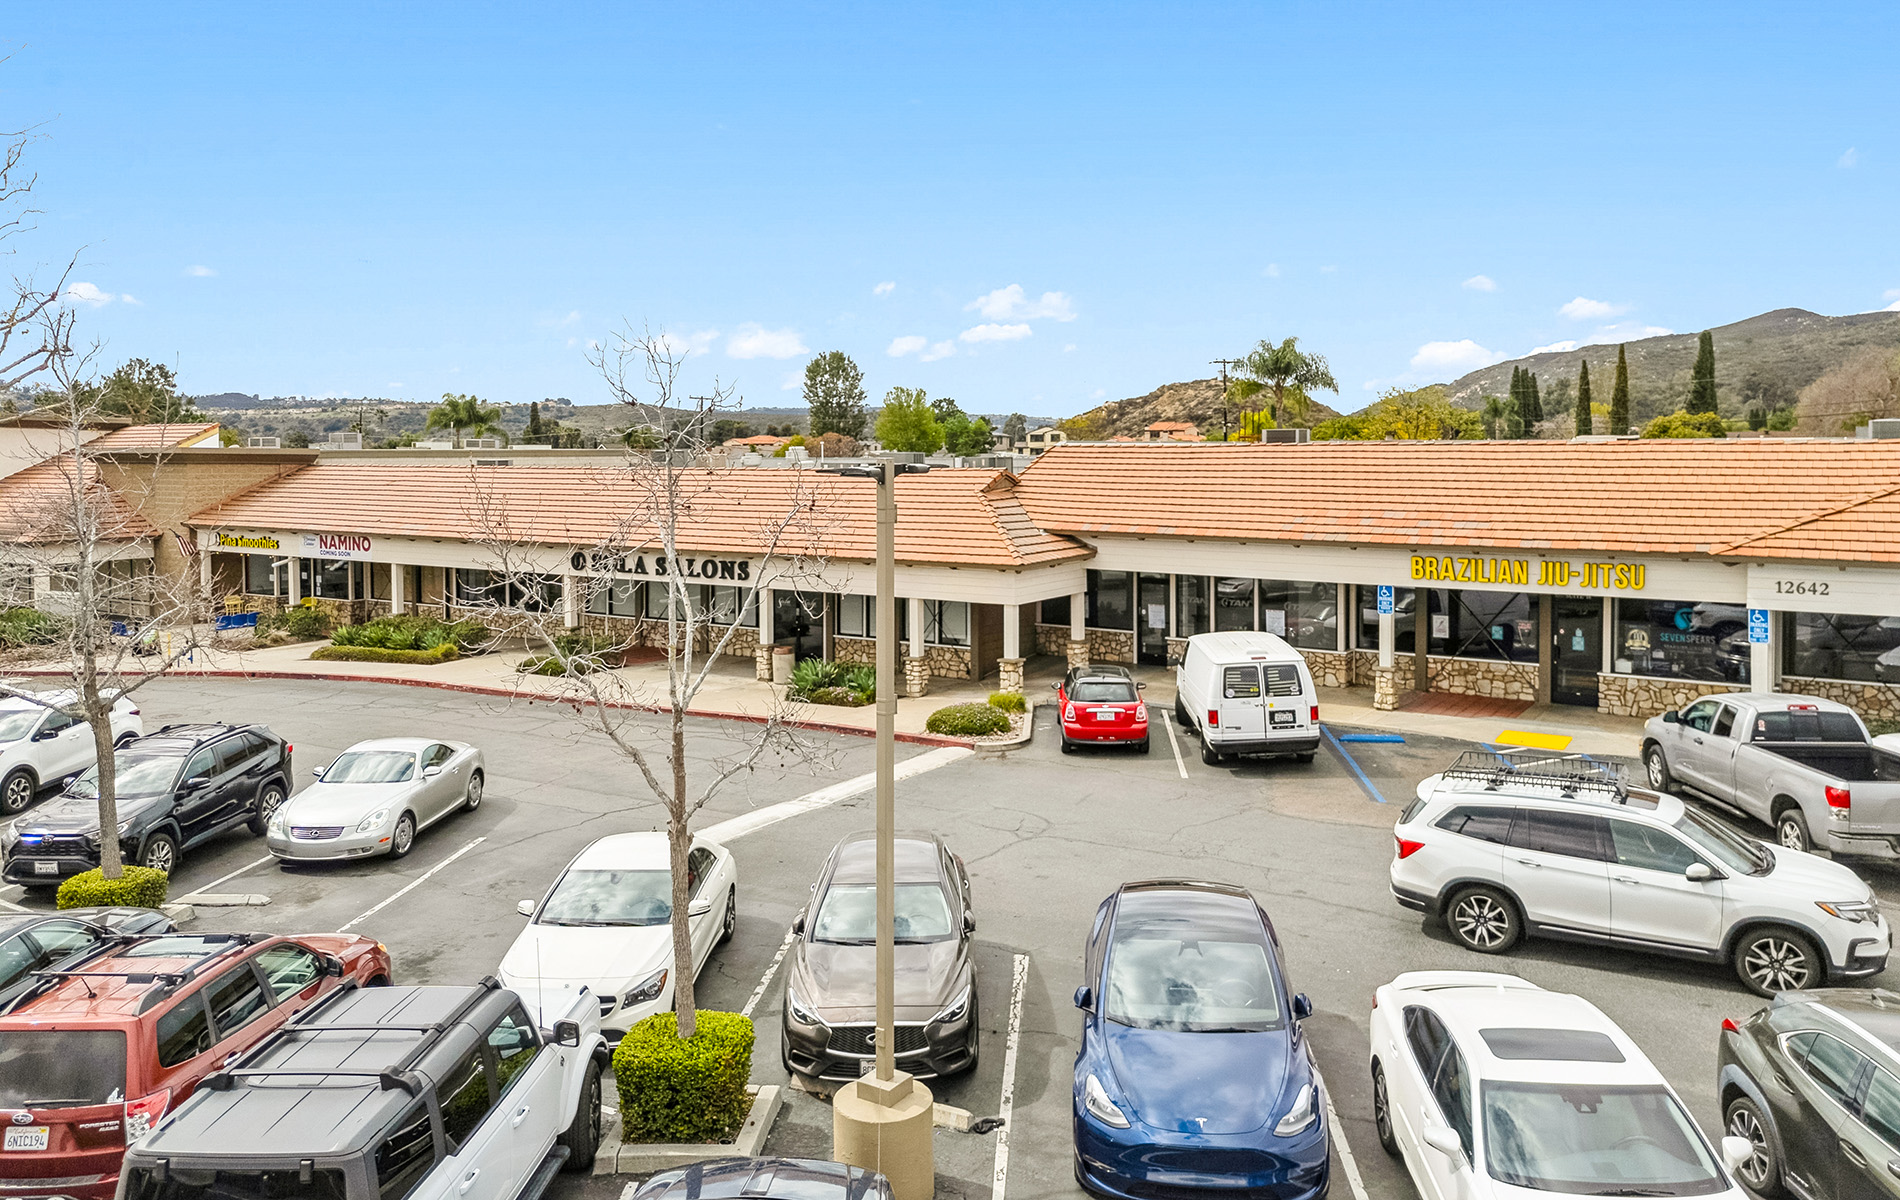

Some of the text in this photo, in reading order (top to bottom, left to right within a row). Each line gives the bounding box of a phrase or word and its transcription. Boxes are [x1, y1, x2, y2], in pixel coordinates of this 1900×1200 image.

[238, 532, 280, 549] Smoothies
[320, 534, 371, 552] NAMINO
[320, 549, 337, 557] COMING
[1411, 556, 1646, 590] BRAZILIAN JIU-JITSU
[1775, 580, 1830, 596] 12642
[7, 1135, 45, 1149] 6NIC194
